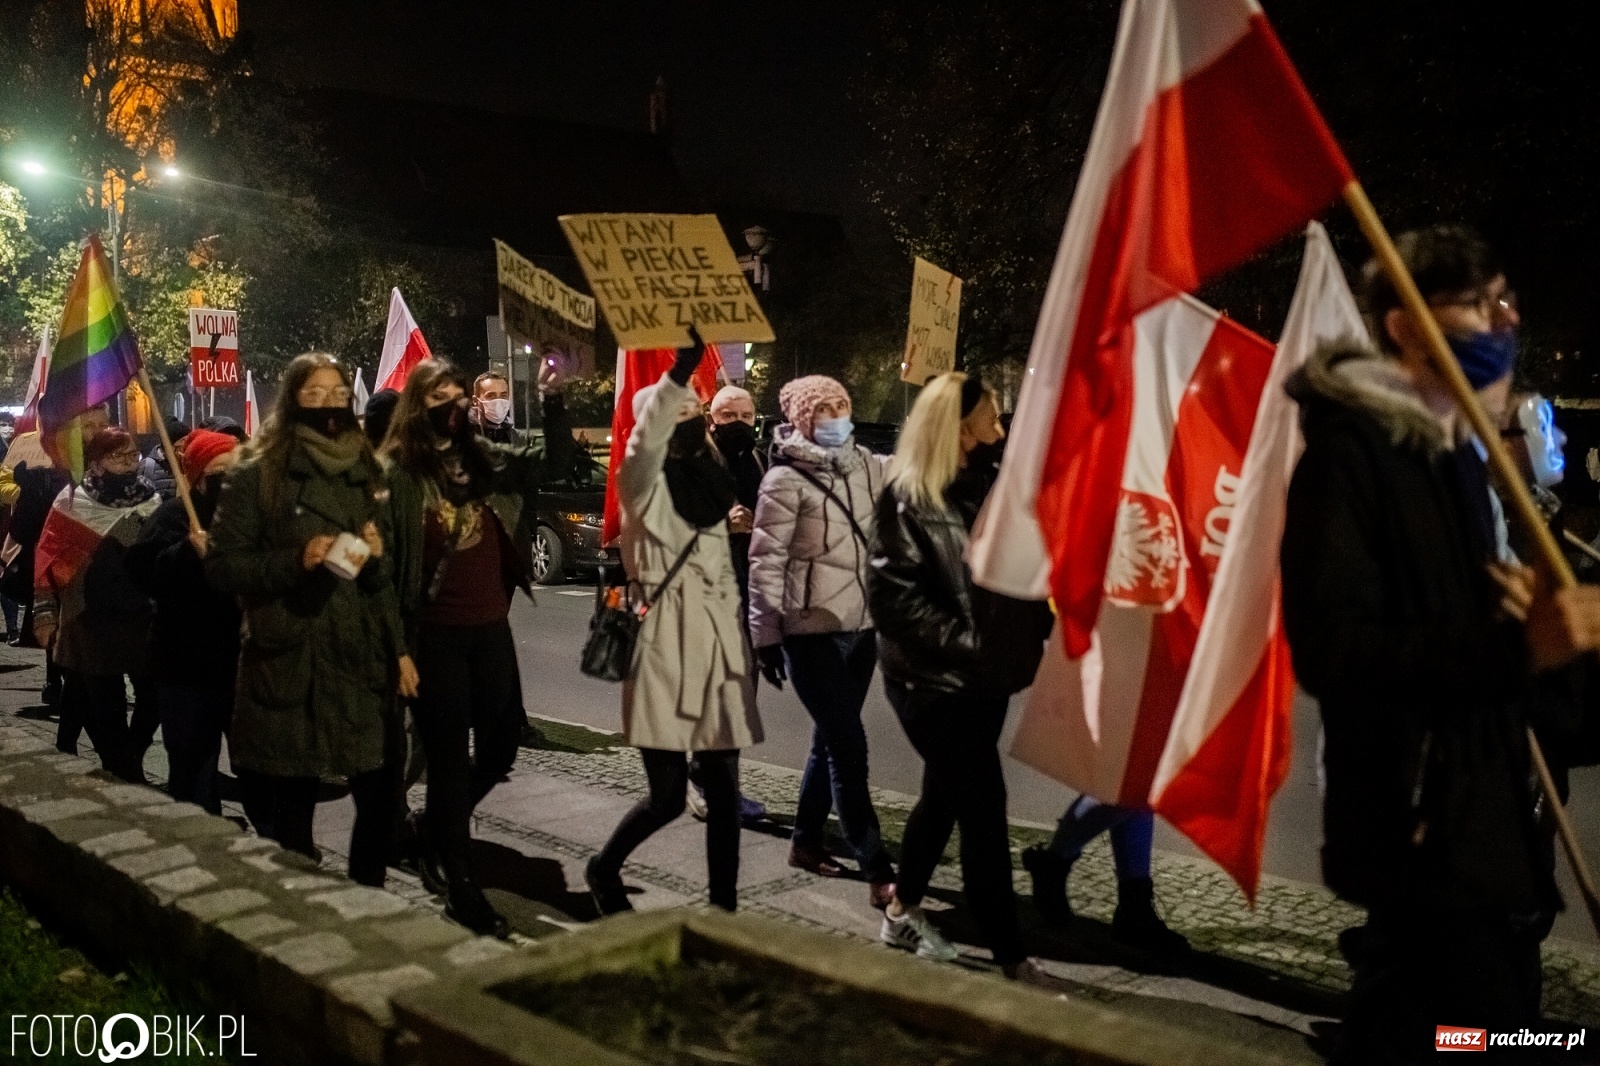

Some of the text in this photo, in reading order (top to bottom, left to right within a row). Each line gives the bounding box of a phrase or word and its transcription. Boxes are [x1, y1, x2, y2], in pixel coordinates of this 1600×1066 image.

[567, 219, 675, 245] WITAMY
[583, 247, 714, 272] W PIEKLE
[500, 246, 534, 288] JAREK
[538, 274, 555, 301] TO
[594, 278, 630, 301] TU
[708, 273, 750, 297] JEST
[195, 314, 237, 337] WOLNA
[609, 303, 664, 333] JAK
[669, 301, 765, 327] ZARAZA
[198, 359, 239, 383] POLKA
